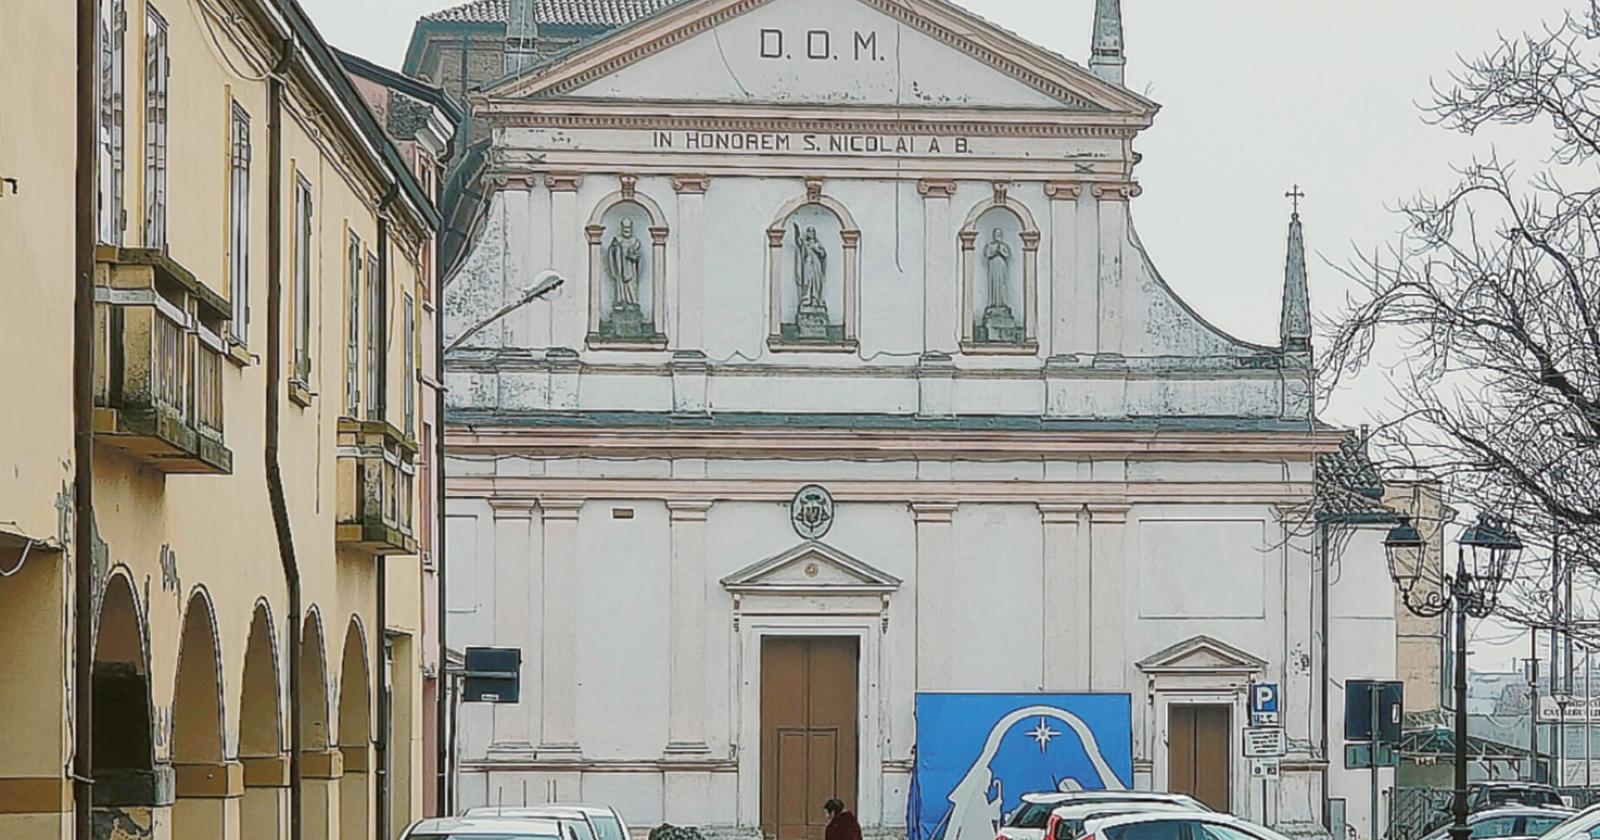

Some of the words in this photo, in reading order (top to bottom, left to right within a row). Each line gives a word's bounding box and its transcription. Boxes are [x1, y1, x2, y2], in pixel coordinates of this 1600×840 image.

[760, 29, 791, 59] D.
[807, 29, 838, 60] O.
[854, 31, 885, 61] M.
[653, 131, 672, 149] IN
[686, 132, 790, 151] HONOREM
[803, 135, 821, 152] S.
[830, 135, 914, 153] NICOLAI
[955, 138, 973, 154] B.
[1256, 687, 1273, 710] P
